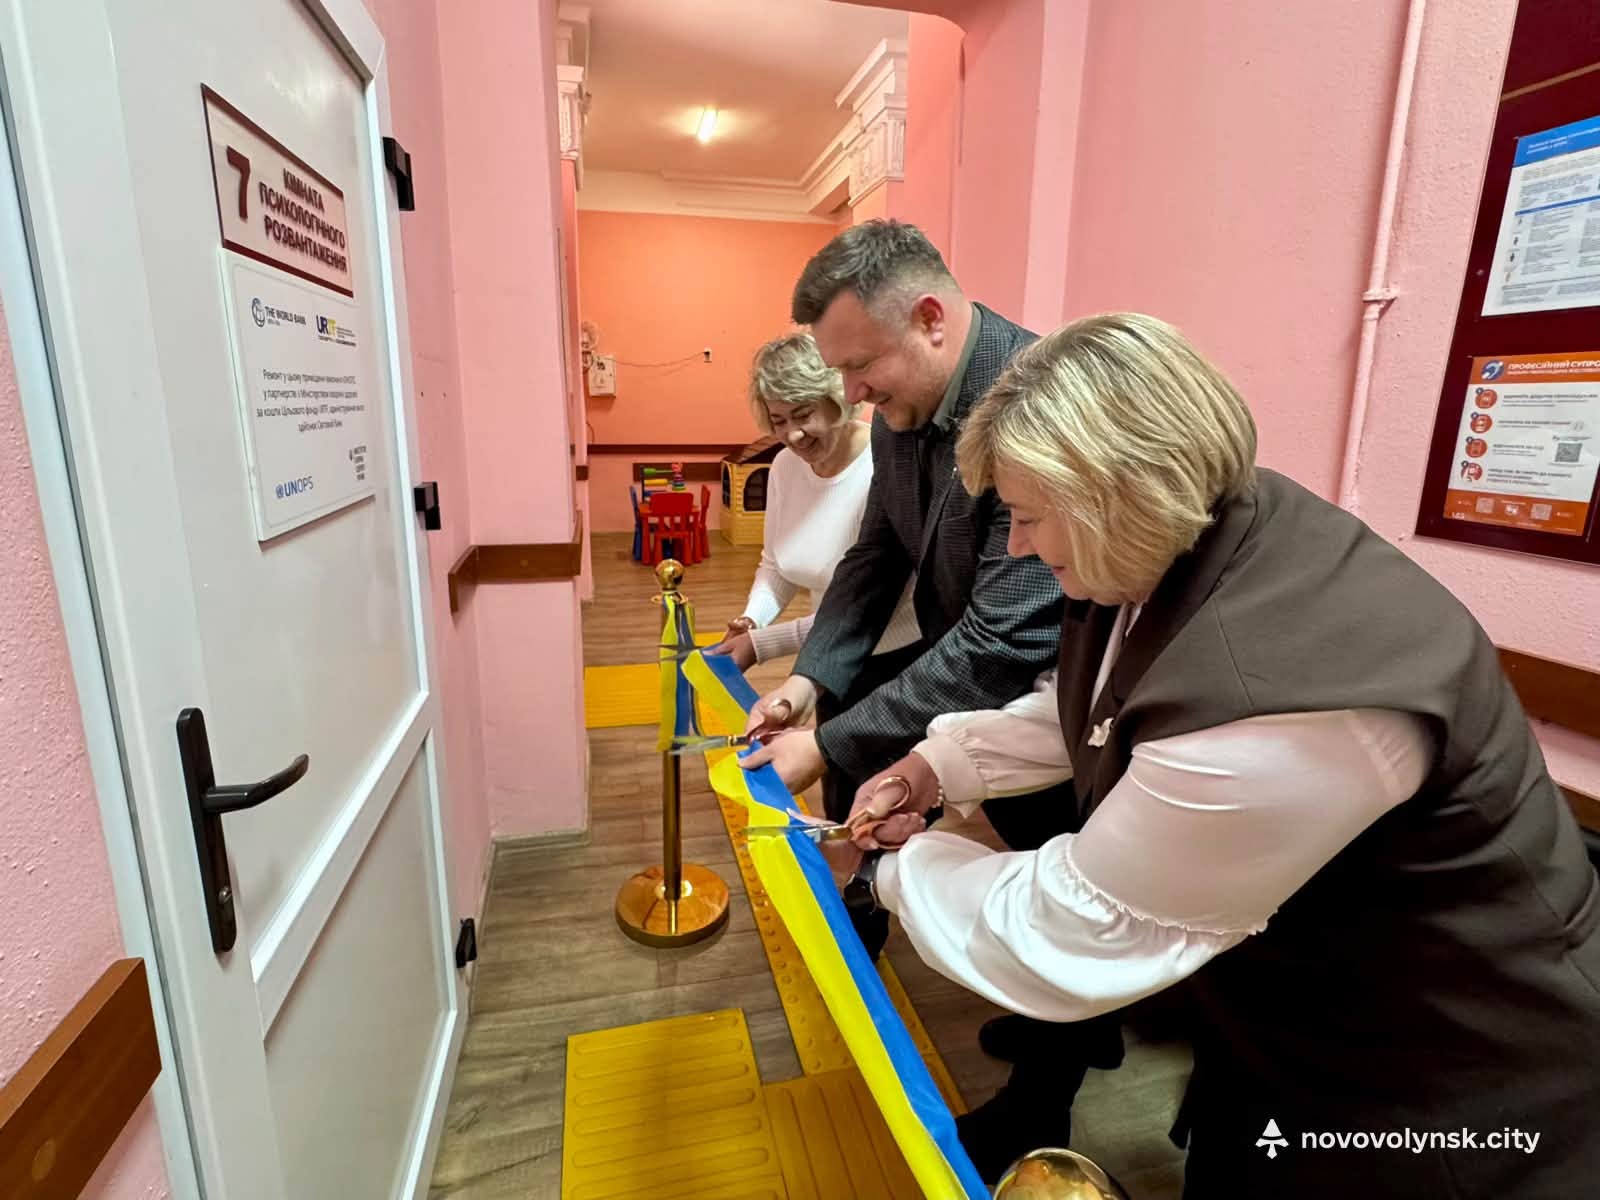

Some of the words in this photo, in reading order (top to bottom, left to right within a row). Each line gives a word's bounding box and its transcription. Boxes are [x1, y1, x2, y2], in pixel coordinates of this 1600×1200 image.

[226, 145, 250, 223] 7
[283, 167, 325, 213] КІМНАТА
[259, 181, 346, 249] ПСИХОЛОГІЧНОГО
[264, 215, 348, 273] РОЗВАНТАЖЕННЯ
[265, 306, 276, 319] THE
[276, 309, 293, 322] WORLD
[284, 475, 314, 497] UNOPS
